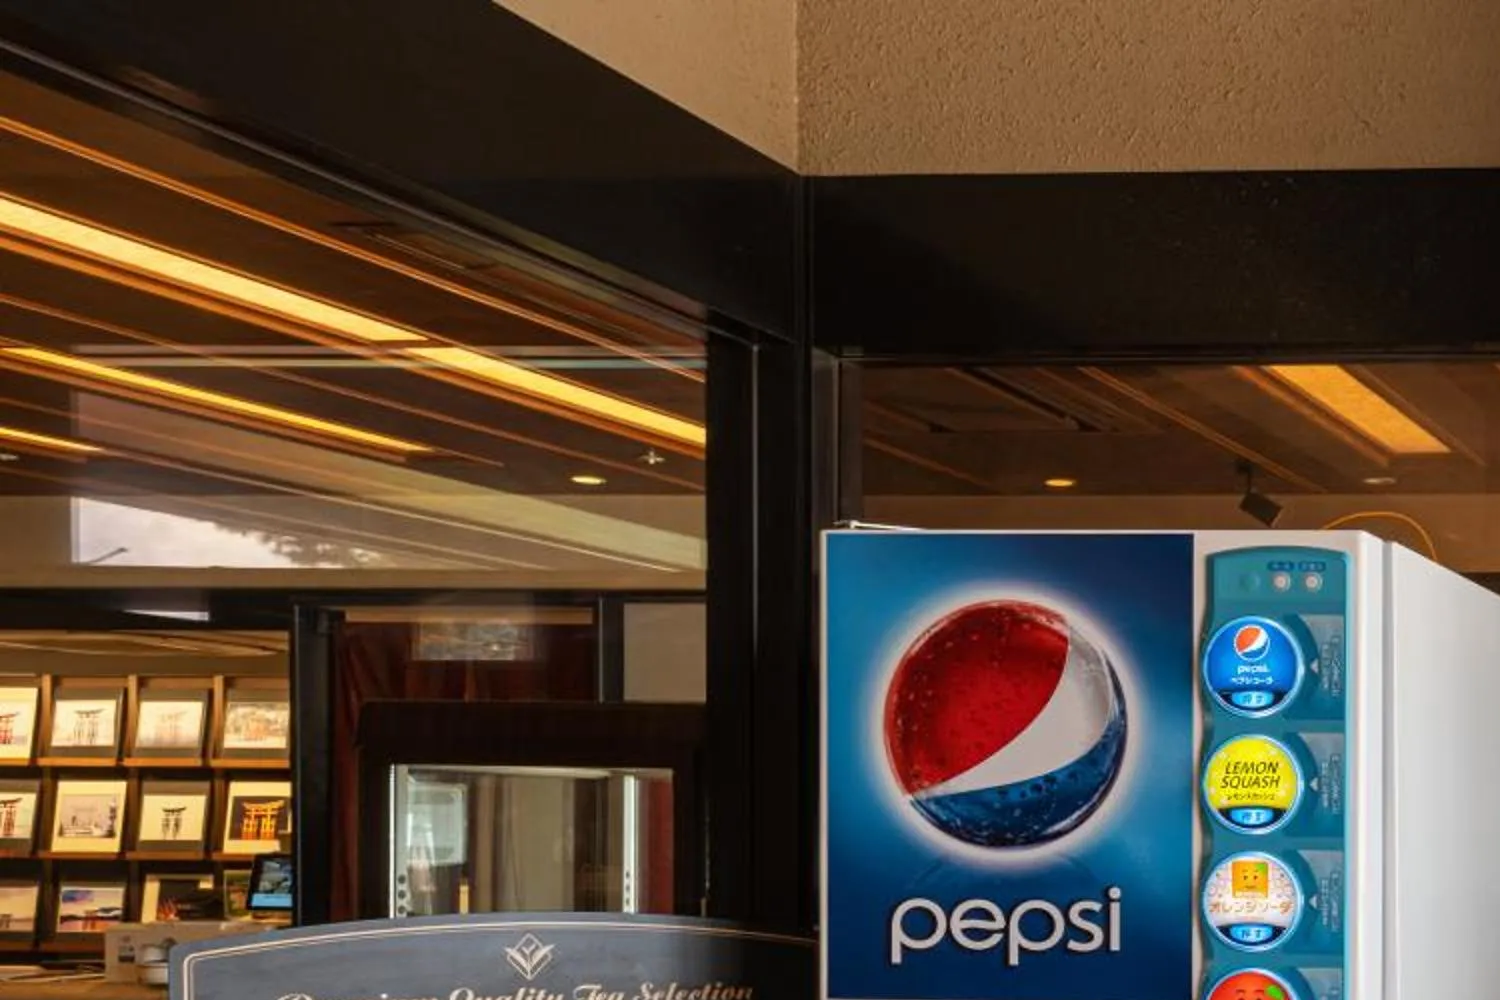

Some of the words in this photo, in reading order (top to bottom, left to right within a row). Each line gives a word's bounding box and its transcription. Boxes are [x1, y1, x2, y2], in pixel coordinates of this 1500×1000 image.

[1224, 761, 1280, 776] LEMON
[1219, 775, 1282, 790] SQUASH
[891, 886, 1122, 966] pepsi
